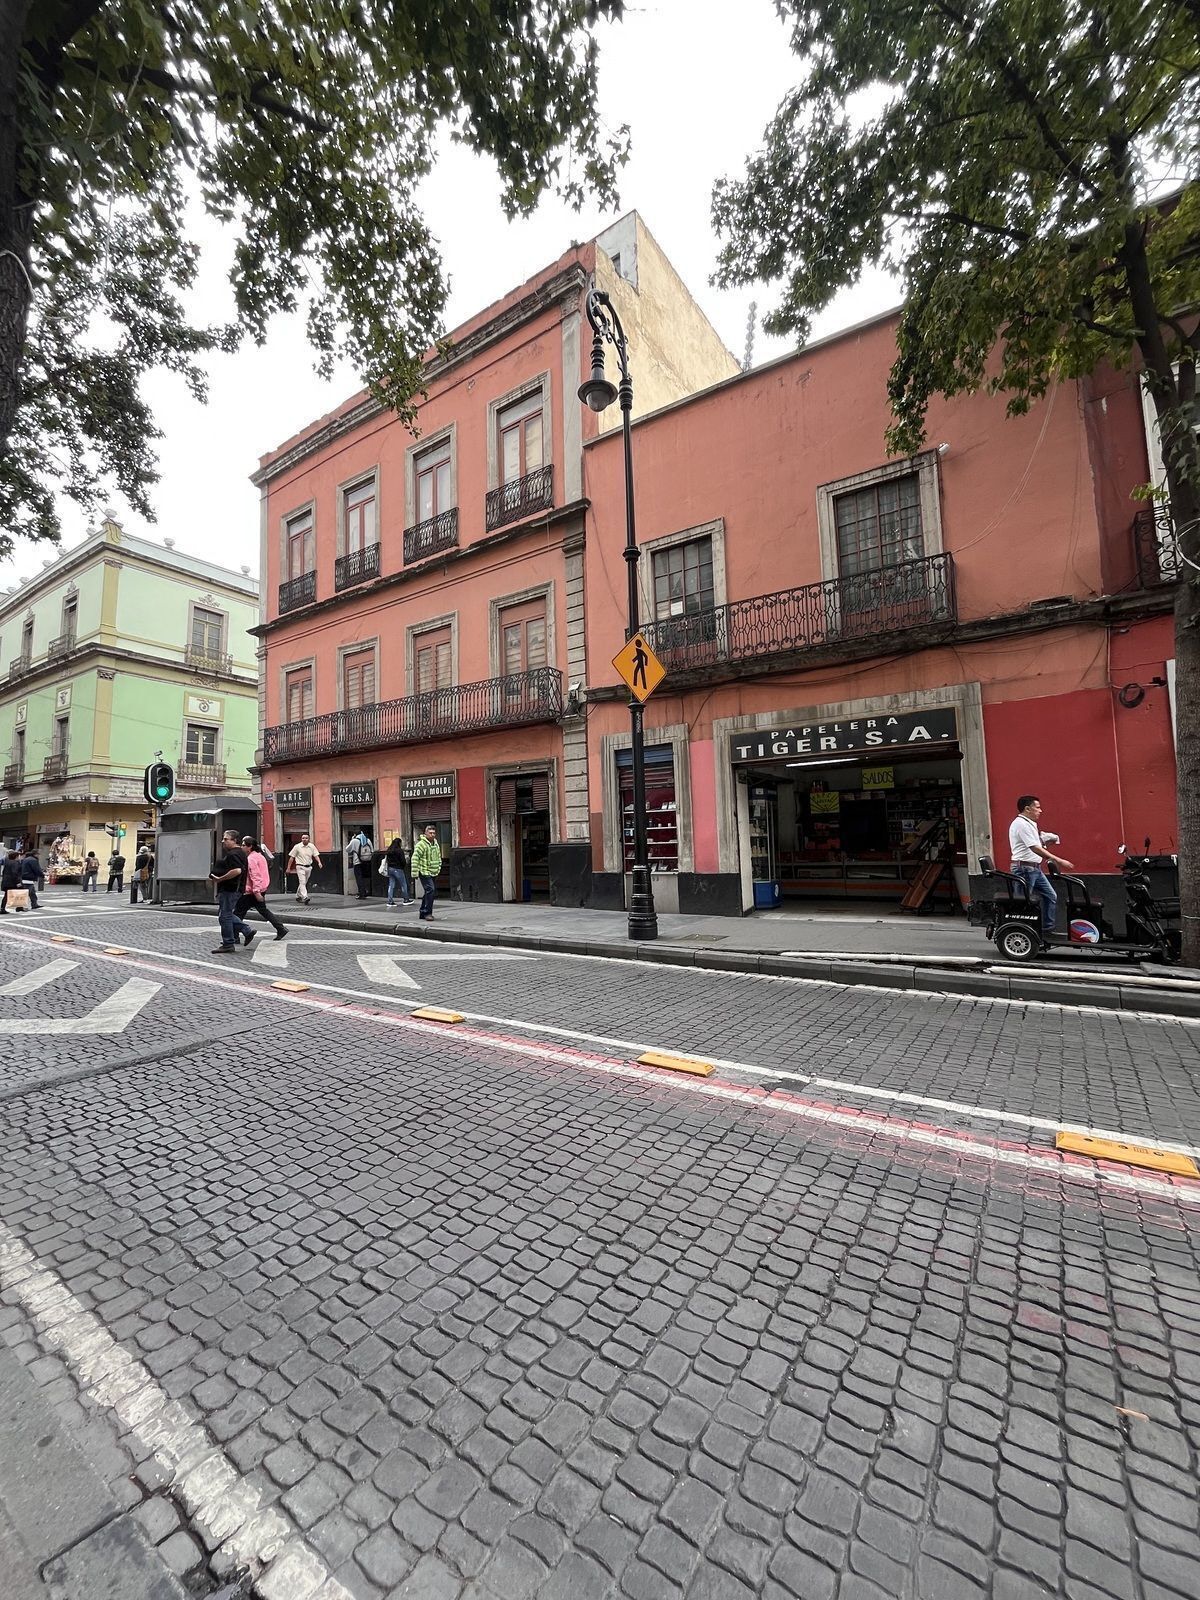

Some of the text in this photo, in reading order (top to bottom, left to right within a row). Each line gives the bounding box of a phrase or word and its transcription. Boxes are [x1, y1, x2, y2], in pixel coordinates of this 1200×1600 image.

[771, 717, 899, 740] PAPELERA
[406, 777, 447, 788] PAPEL KRAFT
[862, 770, 894, 785] SALDOS
[282, 792, 302, 802] ARTE
[402, 786, 452, 798] TRAZO Y MOLDE
